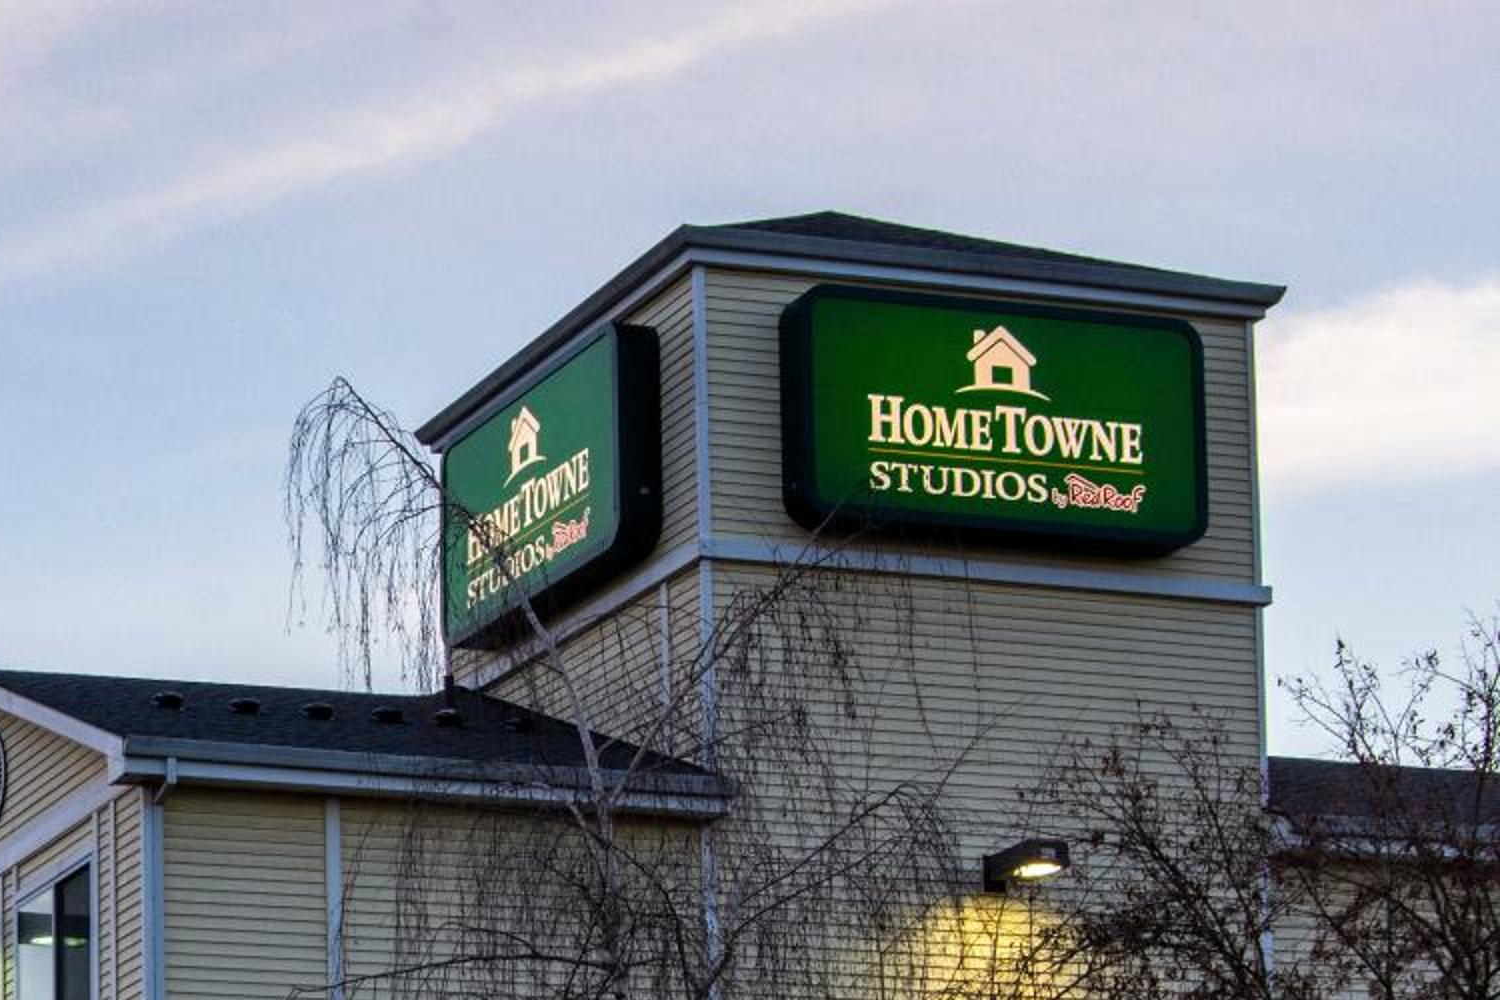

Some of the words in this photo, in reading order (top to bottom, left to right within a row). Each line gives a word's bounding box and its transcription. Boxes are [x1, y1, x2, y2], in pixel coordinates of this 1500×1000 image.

[870, 460, 1048, 502] STUDIOS
[1051, 487, 1068, 509] by
[1069, 479, 1101, 508] Red
[1101, 484, 1146, 513] Roof
